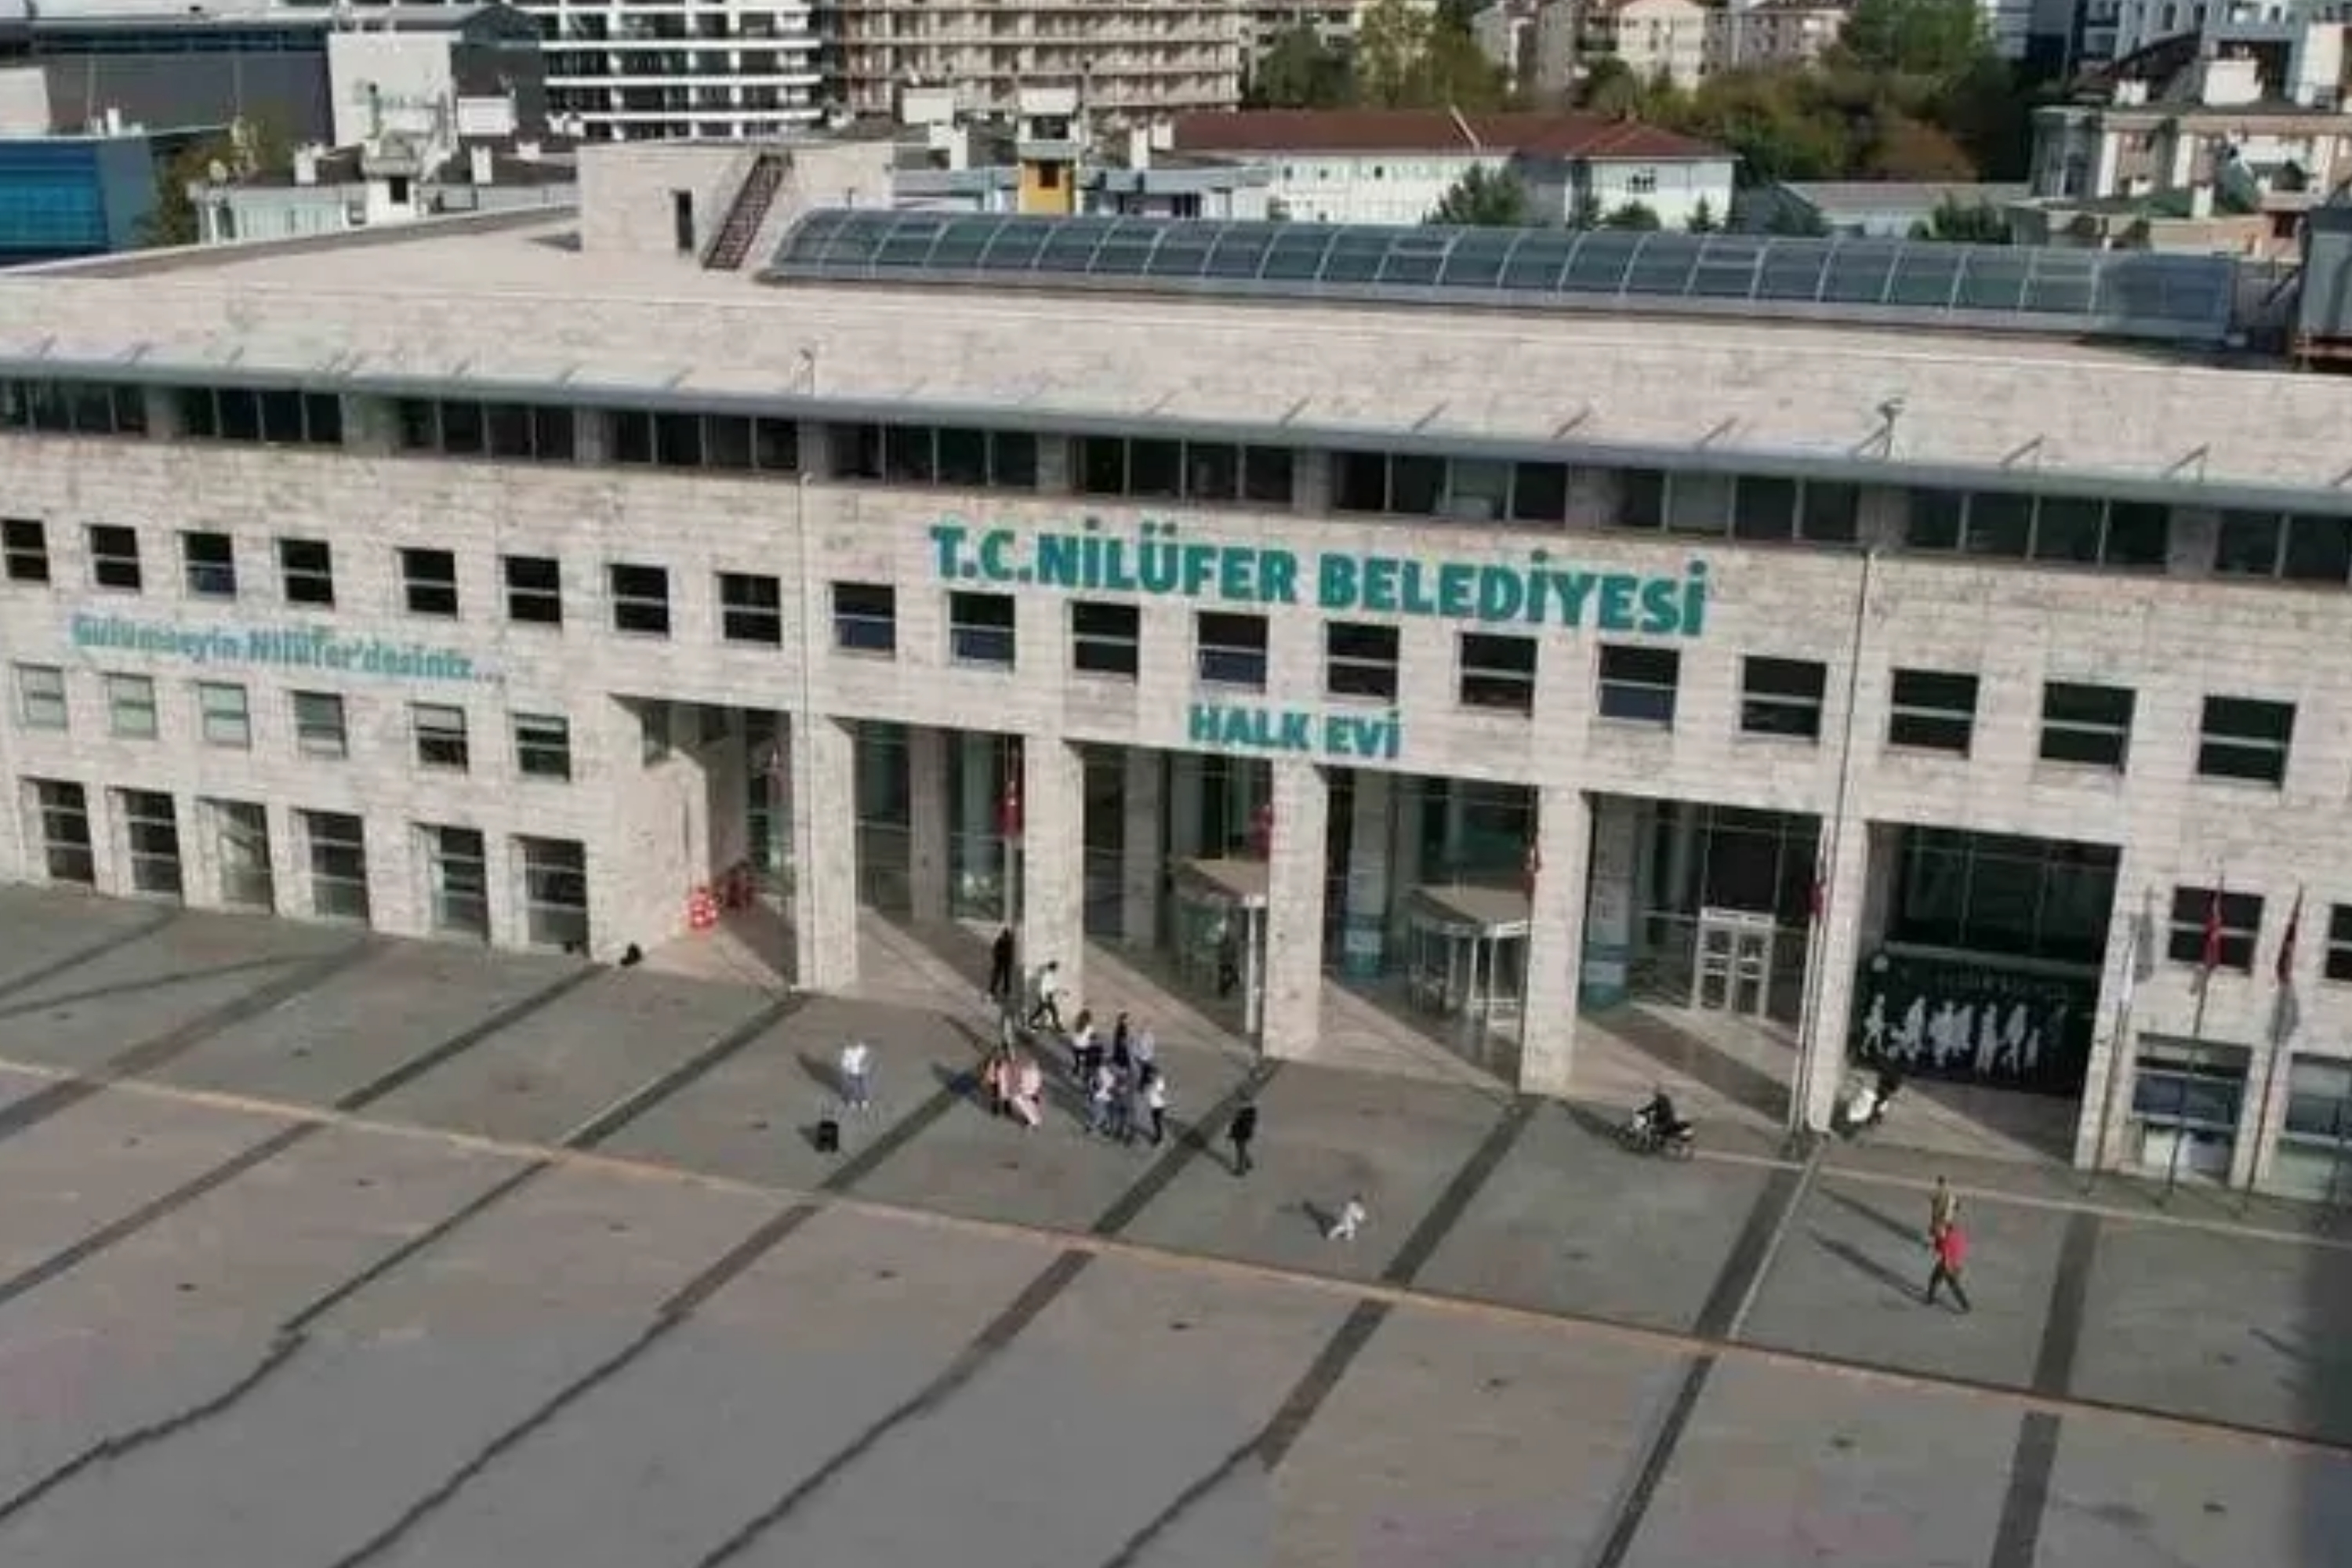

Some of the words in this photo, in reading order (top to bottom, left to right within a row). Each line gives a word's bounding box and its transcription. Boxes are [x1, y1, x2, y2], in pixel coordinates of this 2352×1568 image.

[1319, 550, 1707, 636] BELEDİYESİ
[1189, 703, 1312, 750] HALK
[1326, 710, 1400, 758] EVİ
